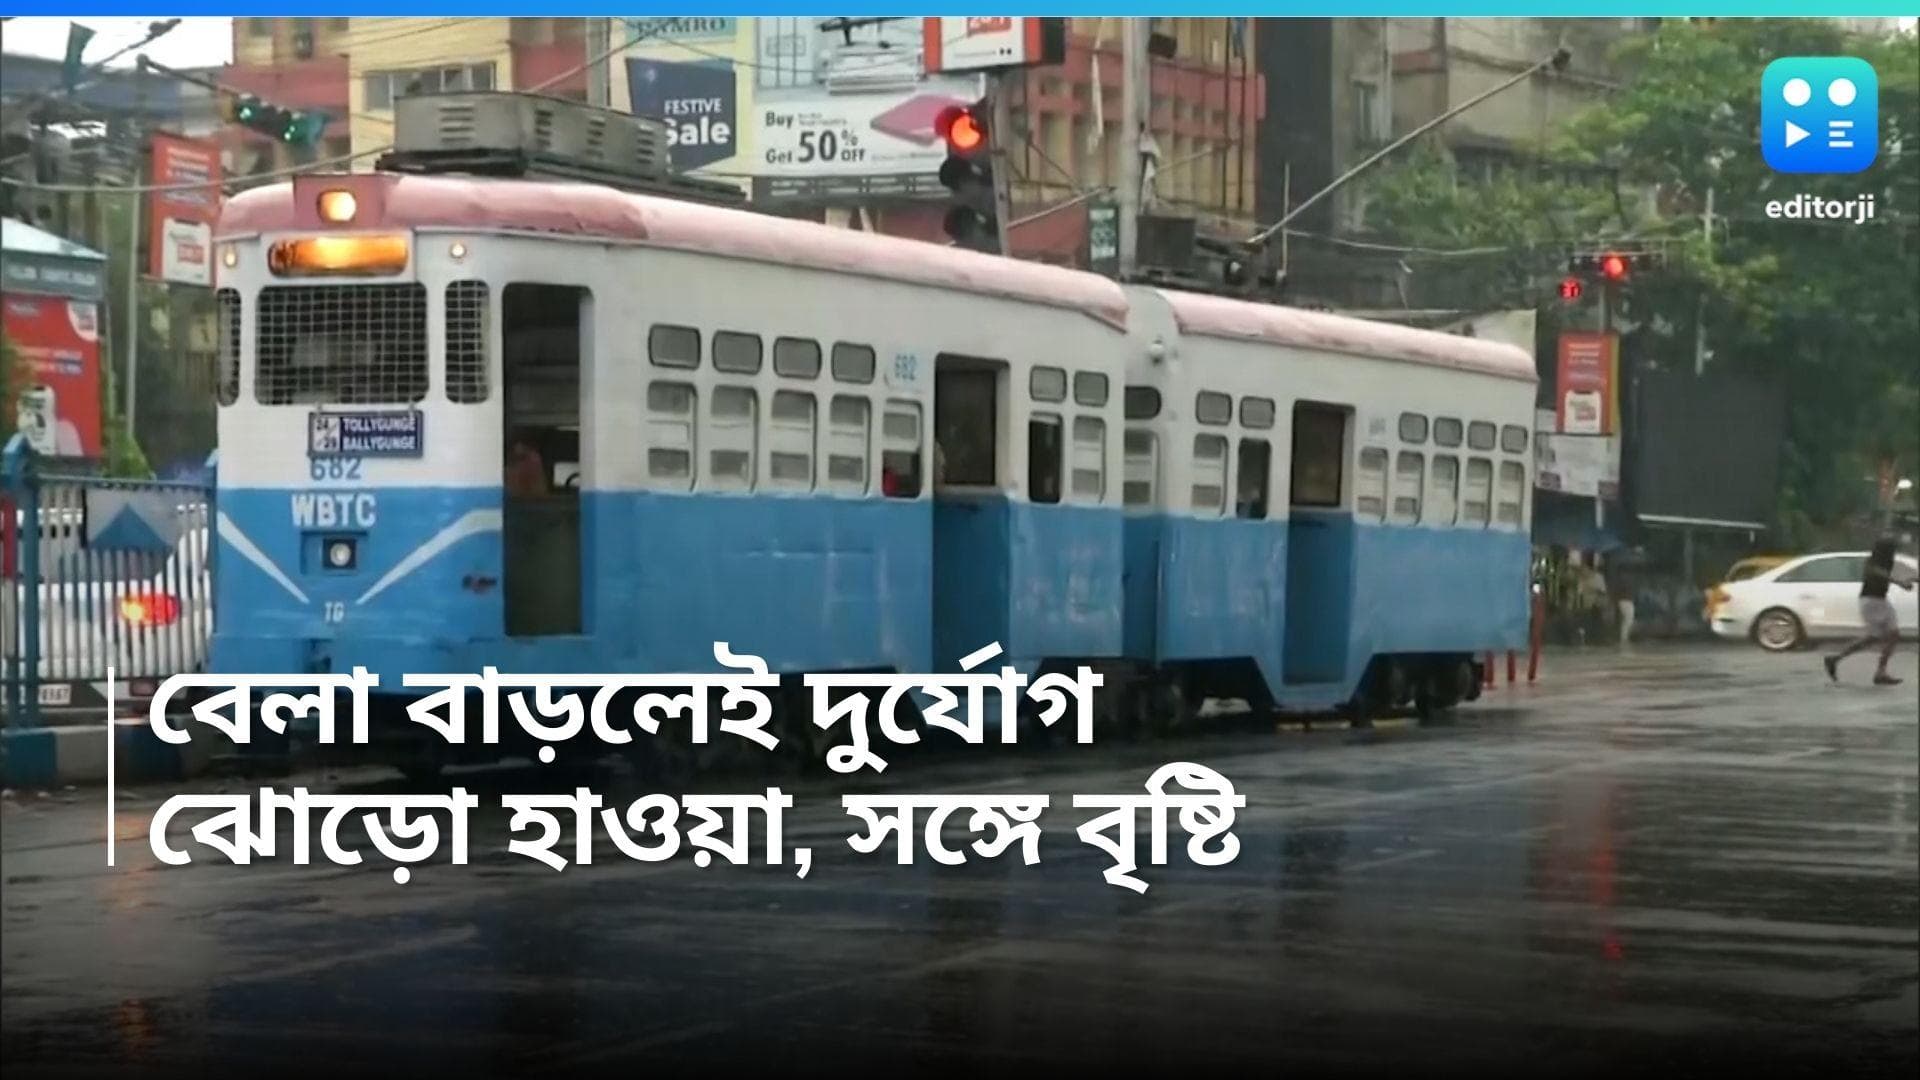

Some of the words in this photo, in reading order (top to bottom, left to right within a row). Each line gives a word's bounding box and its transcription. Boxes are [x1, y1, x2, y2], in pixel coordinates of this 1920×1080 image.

[663, 97, 723, 115] FESTIVE
[765, 112, 794, 128] Buy
[765, 148, 793, 163] Get
[342, 417, 416, 432] TOLLYGUNGE
[342, 436, 416, 450] BALLYGUNGE
[310, 457, 362, 480] 682
[291, 493, 376, 528] WBTC
